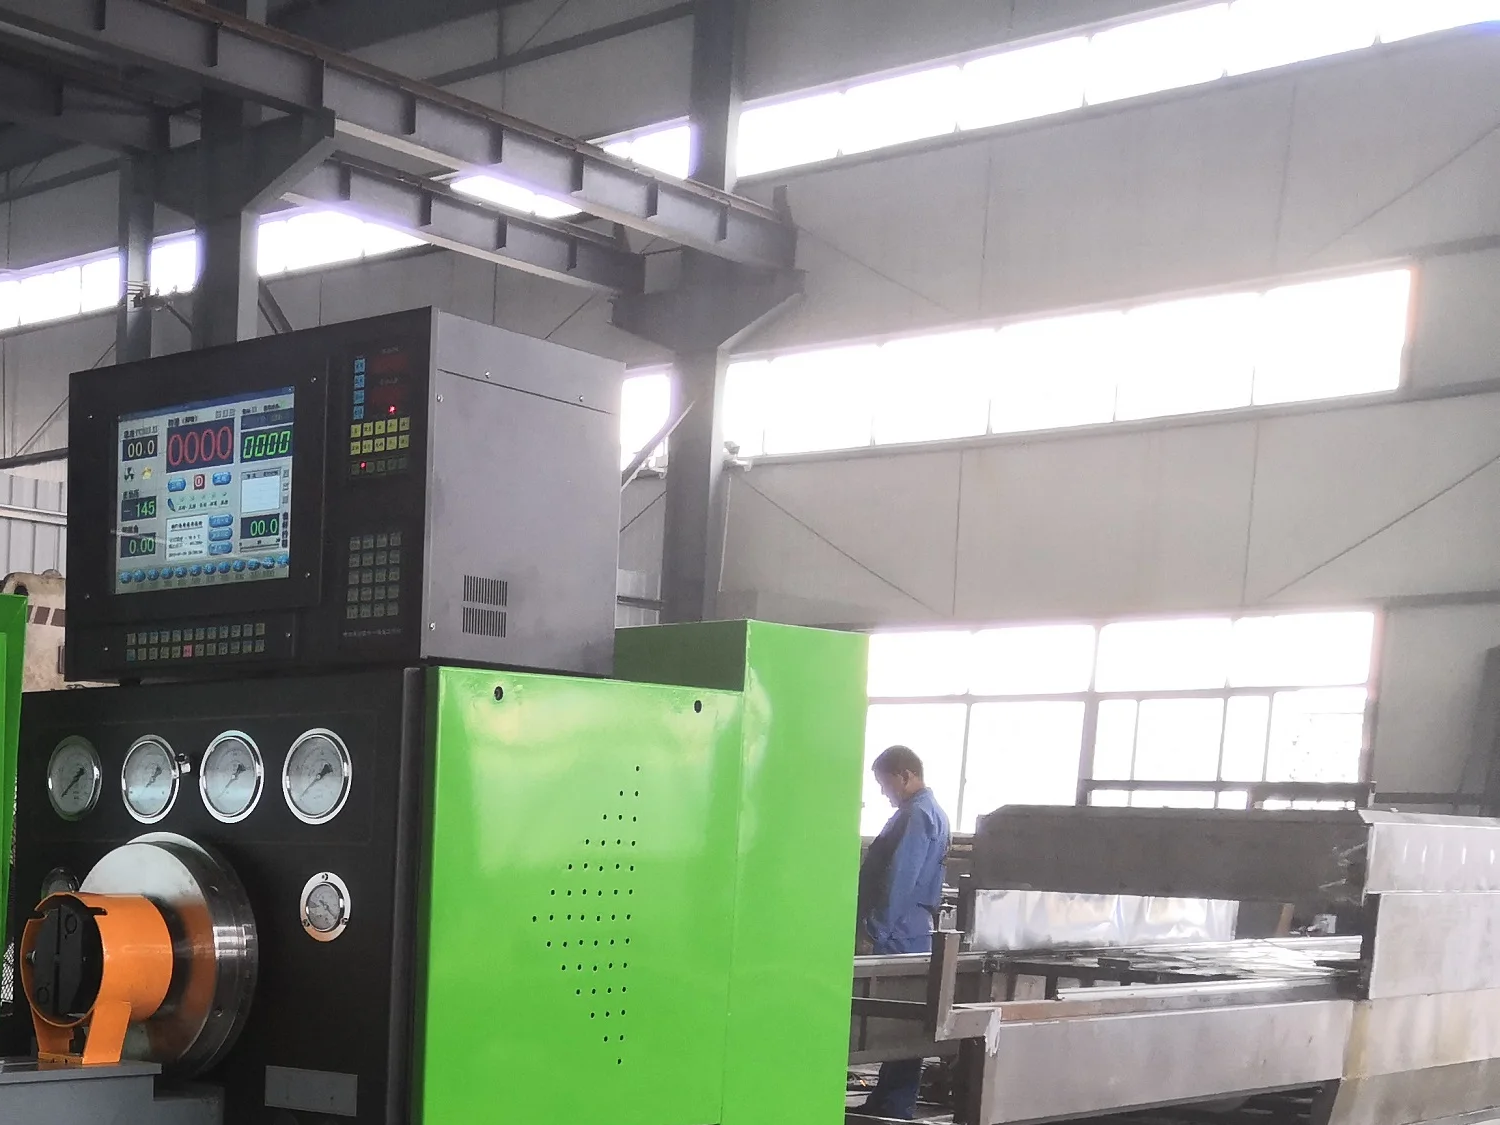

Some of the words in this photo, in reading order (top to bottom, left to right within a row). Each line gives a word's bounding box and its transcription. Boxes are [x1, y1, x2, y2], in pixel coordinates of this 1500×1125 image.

[127, 440, 155, 458] 00.0
[168, 426, 233, 466] 0000
[243, 430, 291, 459] 0000
[250, 518, 278, 536] 00.0
[129, 538, 155, 554] 0.00
